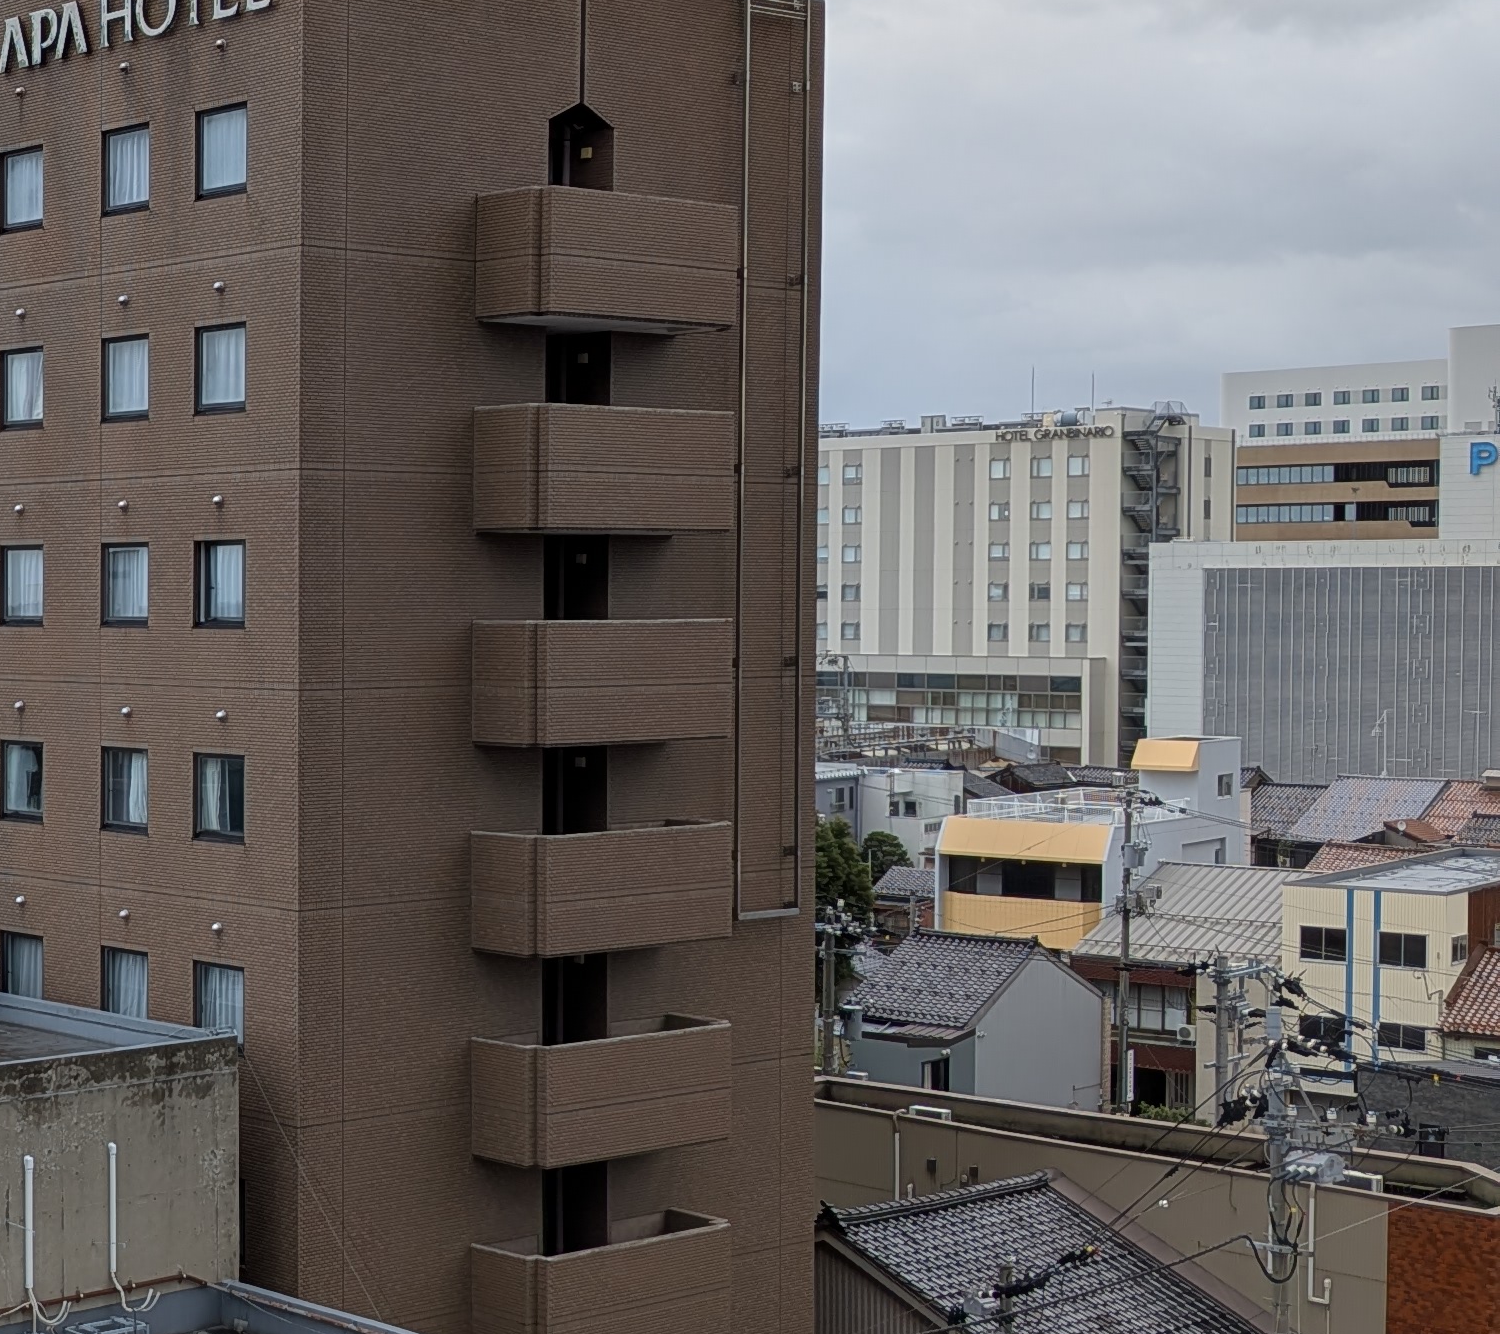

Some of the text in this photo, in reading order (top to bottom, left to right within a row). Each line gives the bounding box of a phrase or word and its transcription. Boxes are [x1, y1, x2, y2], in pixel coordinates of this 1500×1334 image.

[995, 425, 1114, 442] HOTEL GRANBINARIO
[1469, 441, 1499, 476] P
